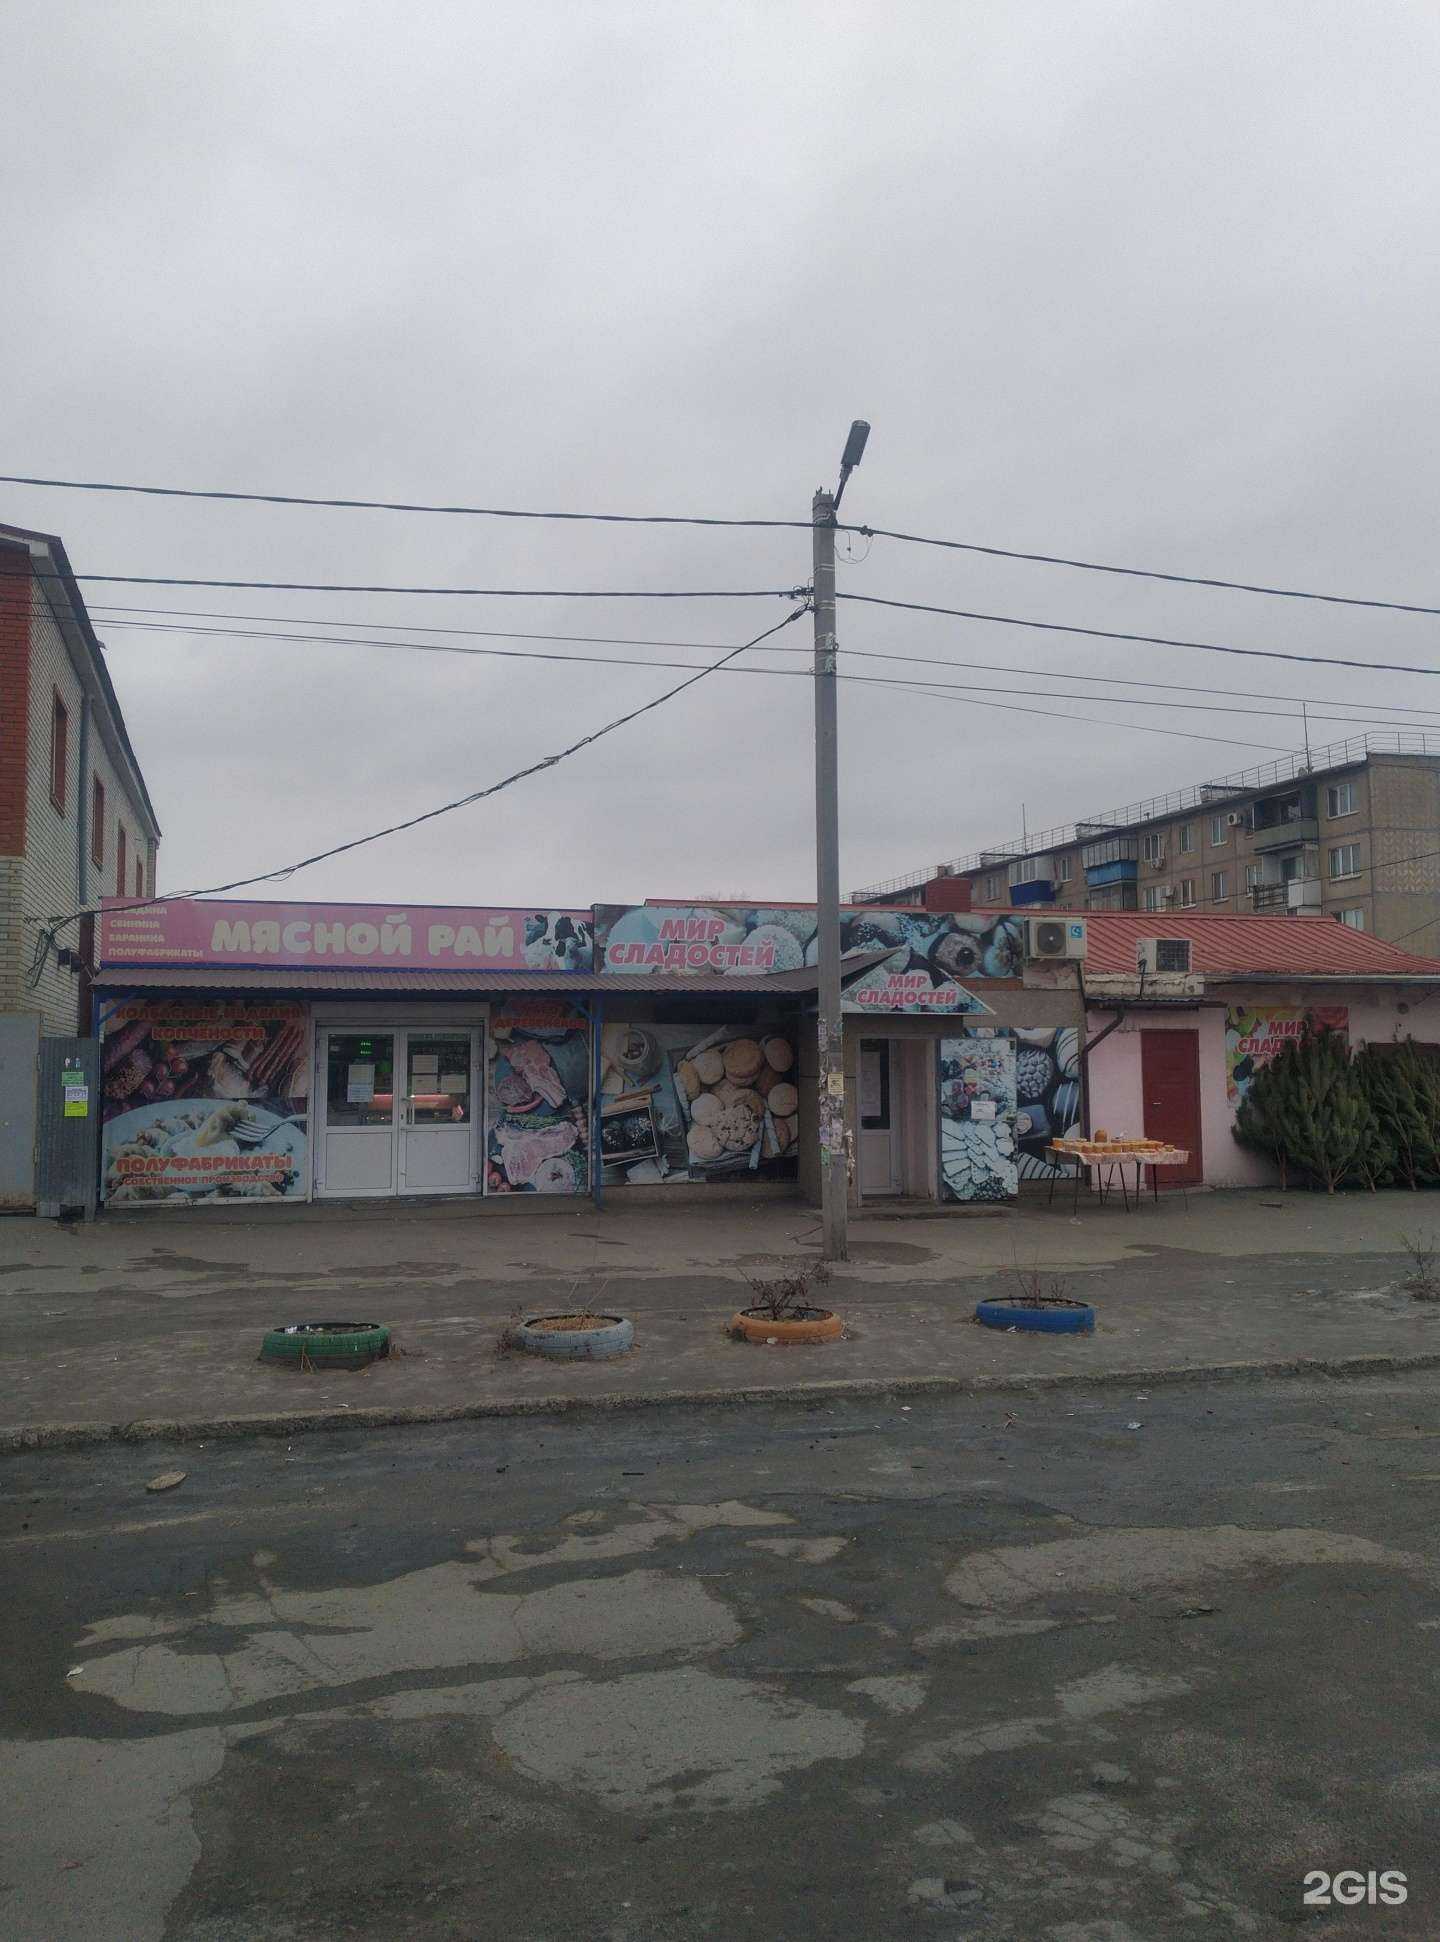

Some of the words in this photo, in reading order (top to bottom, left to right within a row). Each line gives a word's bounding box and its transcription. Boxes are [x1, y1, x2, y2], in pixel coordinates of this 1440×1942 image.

[211, 913, 412, 956] МЯСНОЙ
[428, 915, 515, 957] РАЙ
[659, 918, 726, 941] МИР
[108, 947, 204, 958] ПОЛУФАБРИКАТЫ
[608, 939, 775, 970] СЛАДОСТЕЙ
[887, 975, 928, 988] МИР
[857, 988, 957, 1006] СЛАДОСТЕЙ
[116, 1154, 292, 1173] ПОЛУФАБРИКАТЫ
